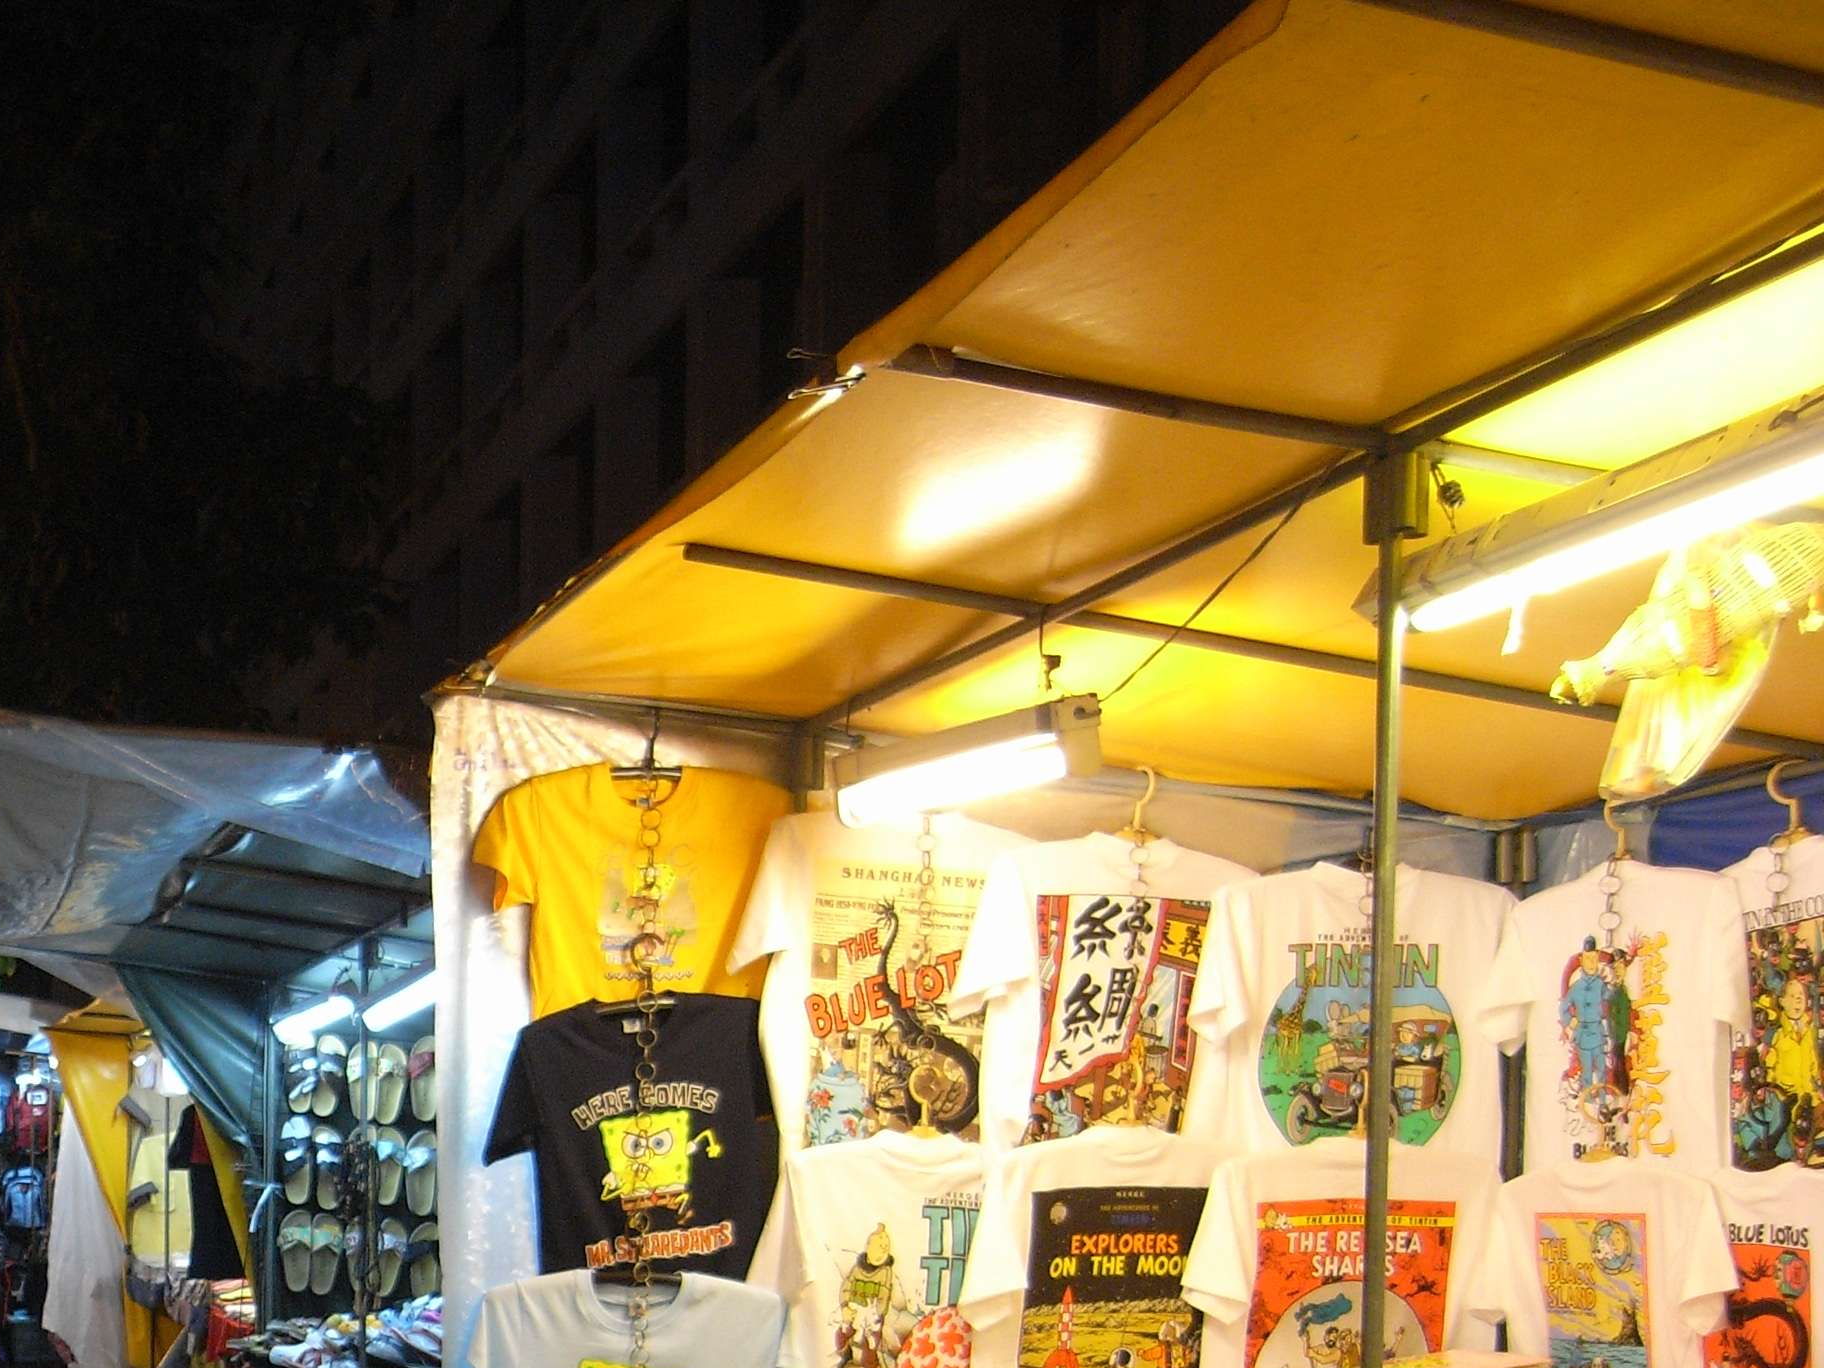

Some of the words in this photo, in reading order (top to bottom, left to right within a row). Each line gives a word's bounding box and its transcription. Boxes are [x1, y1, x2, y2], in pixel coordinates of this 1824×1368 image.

[837, 926, 883, 966] THE
[804, 974, 890, 1039] BLUE
[895, 949, 963, 1010] LOT
[570, 1085, 634, 1132] HERE
[638, 1082, 720, 1115] COMES
[1328, 1215, 1365, 1225] ADVENT
[1408, 1217, 1439, 1226] TINTIN
[1070, 1233, 1180, 1256] EXPLORERS
[1287, 1231, 1328, 1254] THE
[1335, 1231, 1364, 1254] RE
[1384, 1231, 1423, 1254] SEA
[1728, 1222, 1765, 1243] BLUE
[1769, 1223, 1809, 1249] LOTUS
[1539, 1237, 1569, 1262] THE
[1049, 1255, 1077, 1279] ON
[1091, 1255, 1126, 1277] THE
[1311, 1255, 1395, 1278] SHARS
[1547, 1260, 1596, 1286] BLACK
